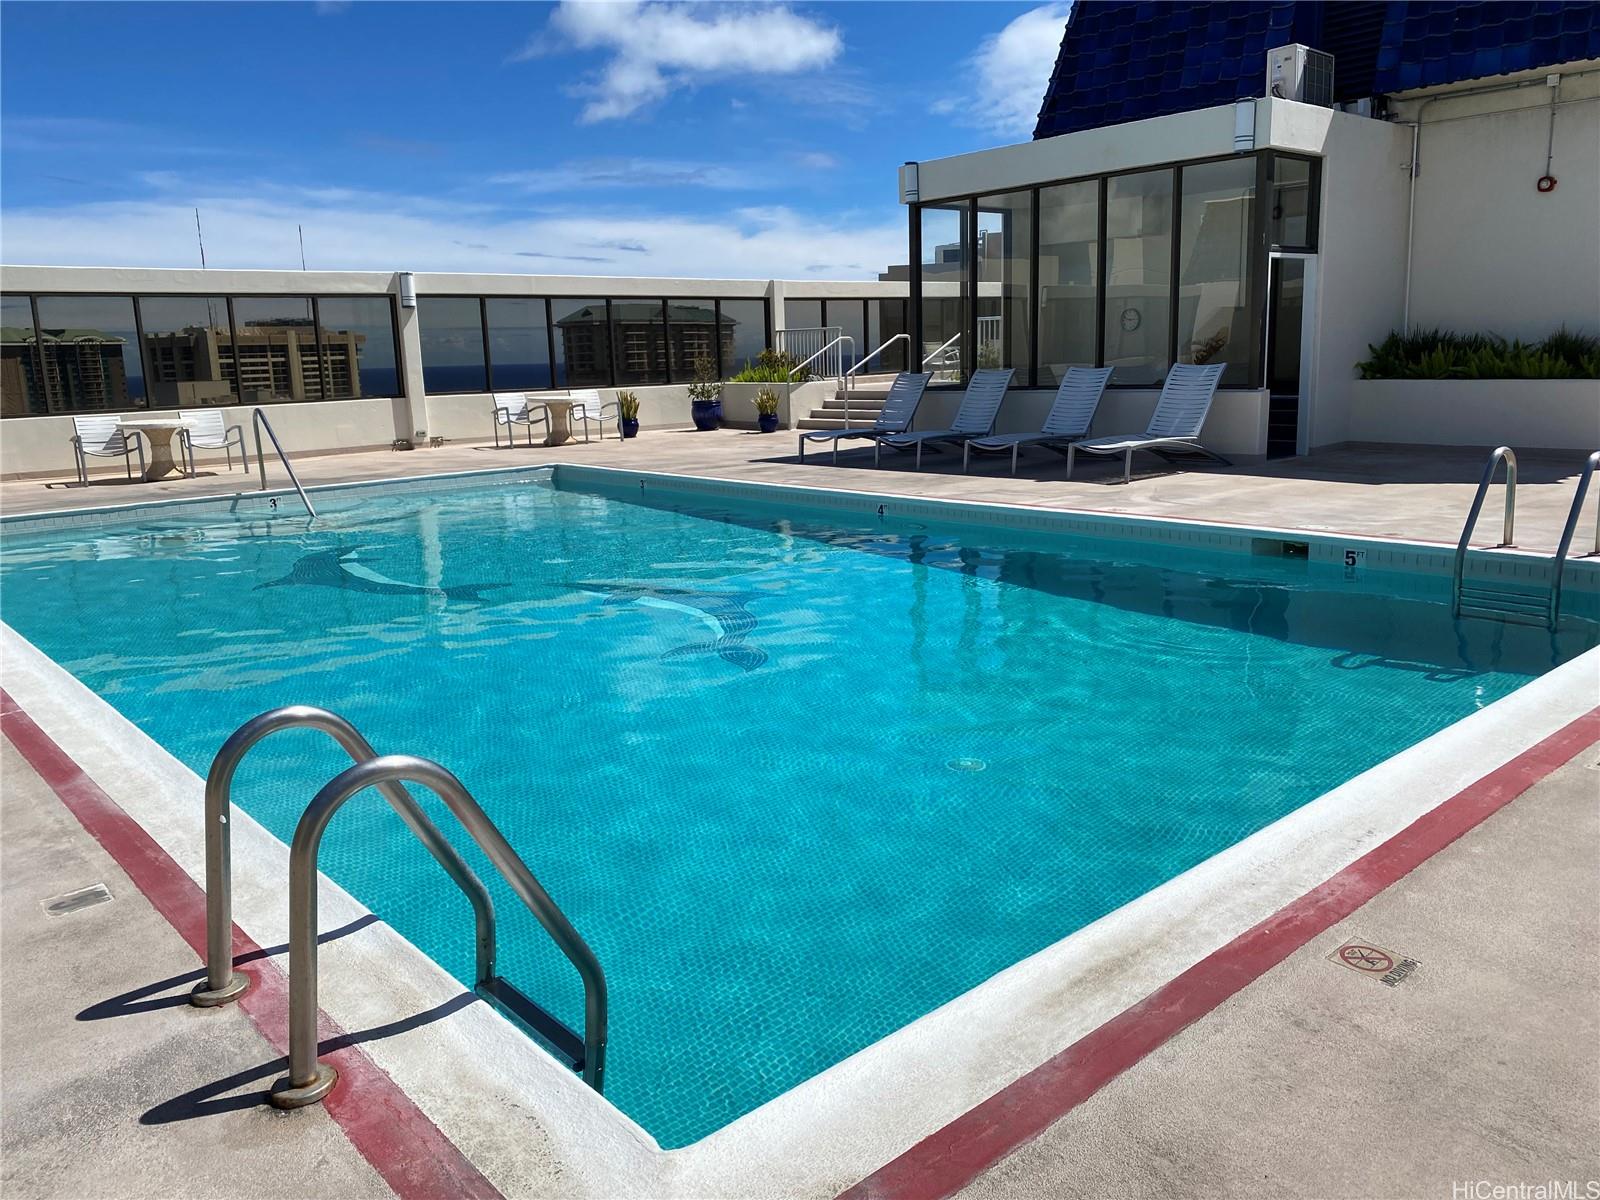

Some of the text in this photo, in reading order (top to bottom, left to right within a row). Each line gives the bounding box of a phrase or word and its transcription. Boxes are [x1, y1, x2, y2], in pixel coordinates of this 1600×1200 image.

[269, 498, 277, 509] 3
[877, 504, 884, 514] 4
[1345, 550, 1356, 566] 5
